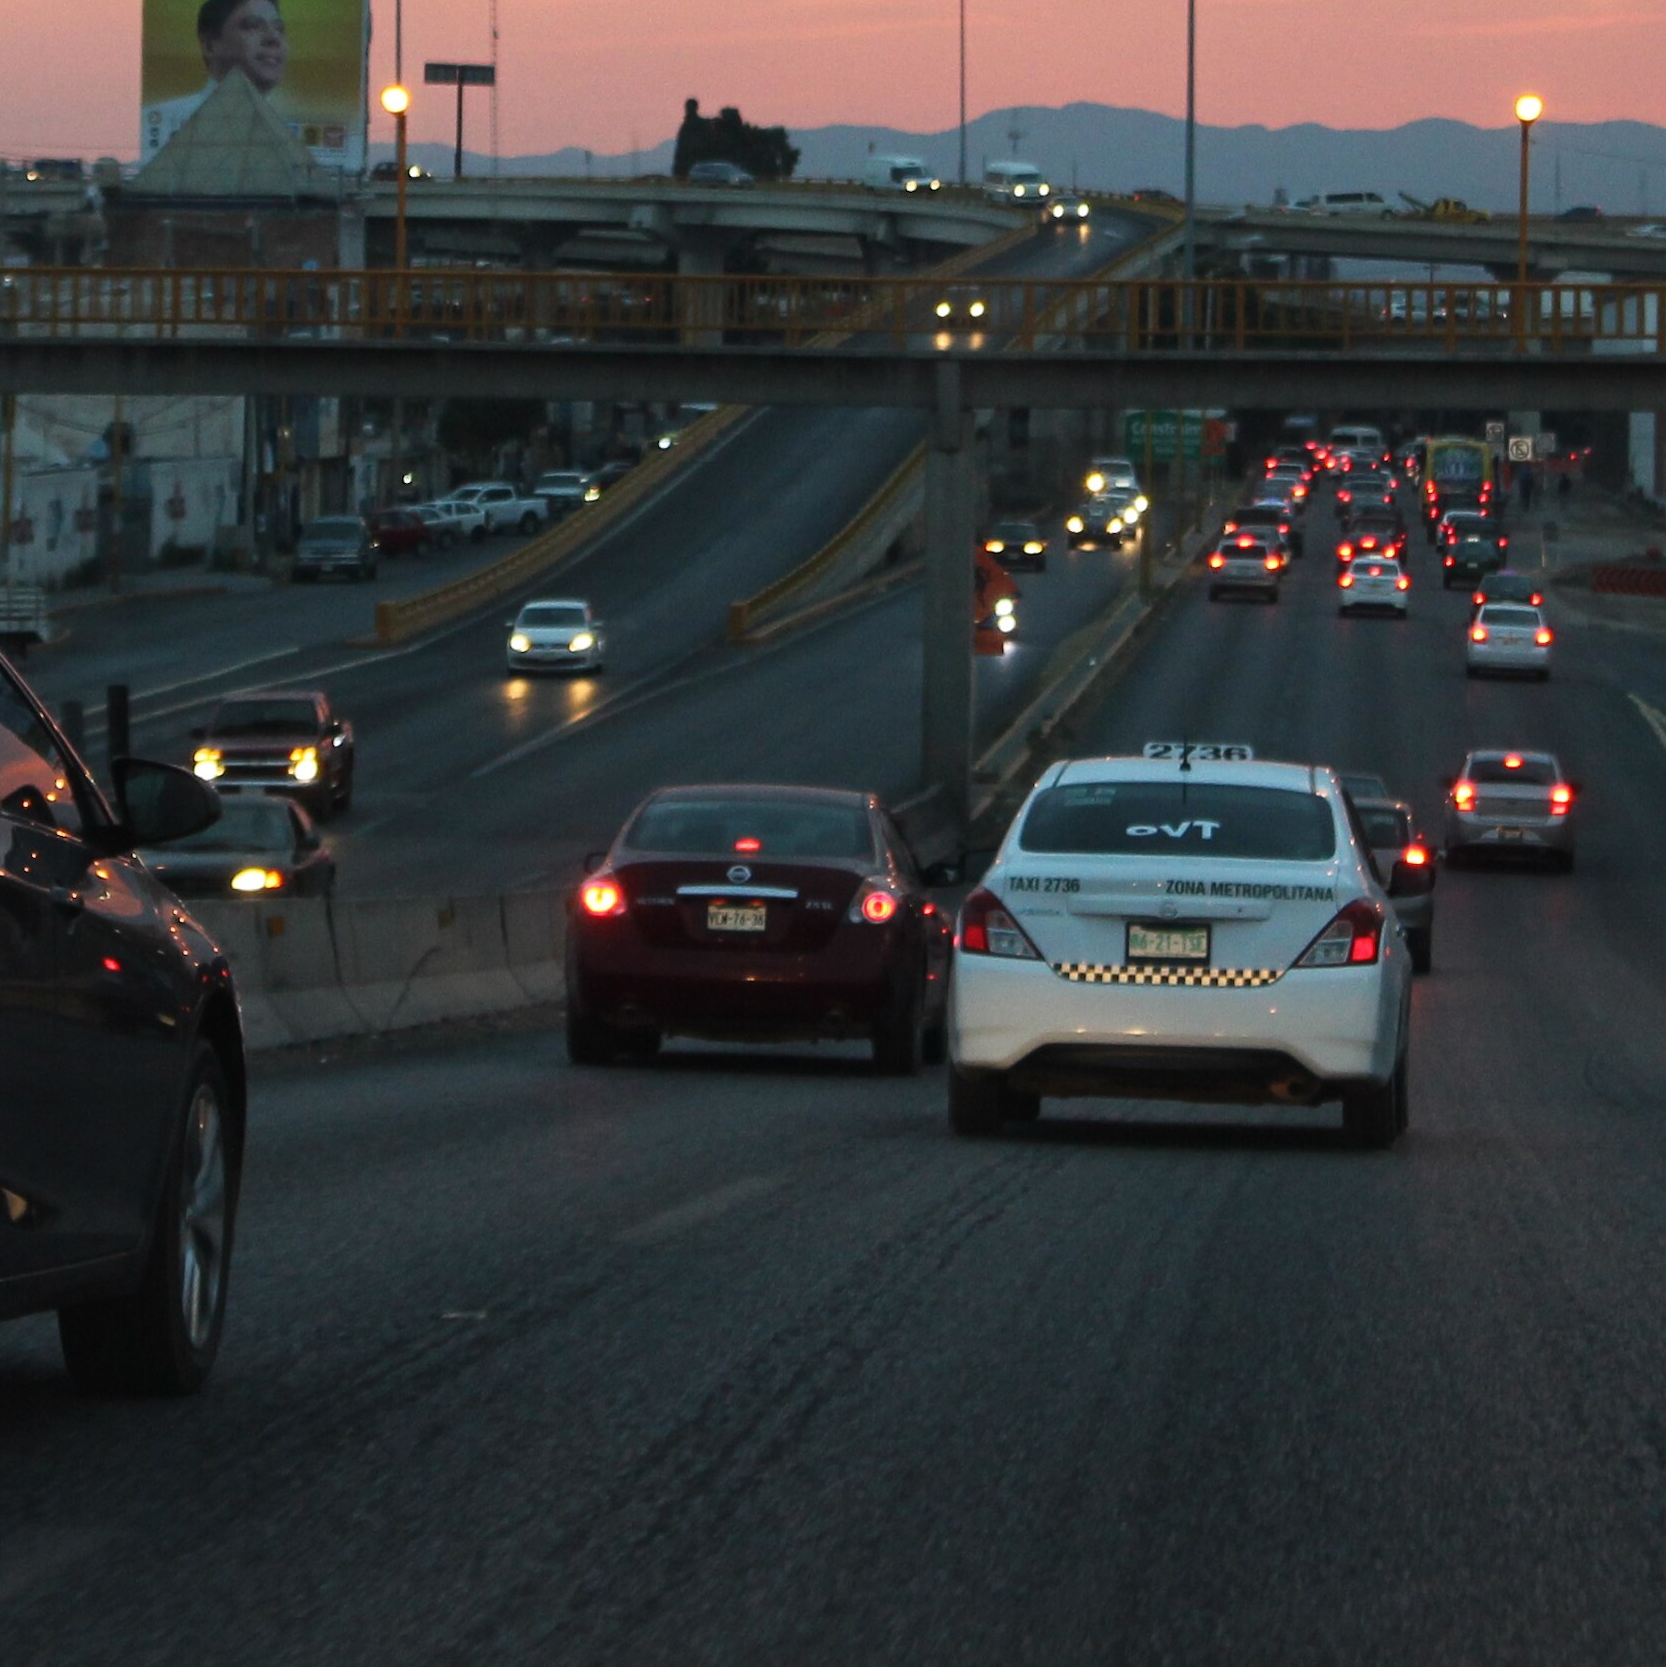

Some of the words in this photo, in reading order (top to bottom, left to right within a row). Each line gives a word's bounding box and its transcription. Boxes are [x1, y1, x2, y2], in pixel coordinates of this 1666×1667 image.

[1148, 743, 1250, 761] 2736
[1009, 877, 1040, 892] TAXI
[1042, 878, 1081, 893] 2736
[1166, 880, 1206, 895] ZONA
[1210, 881, 1334, 901] METROPOLITANA
